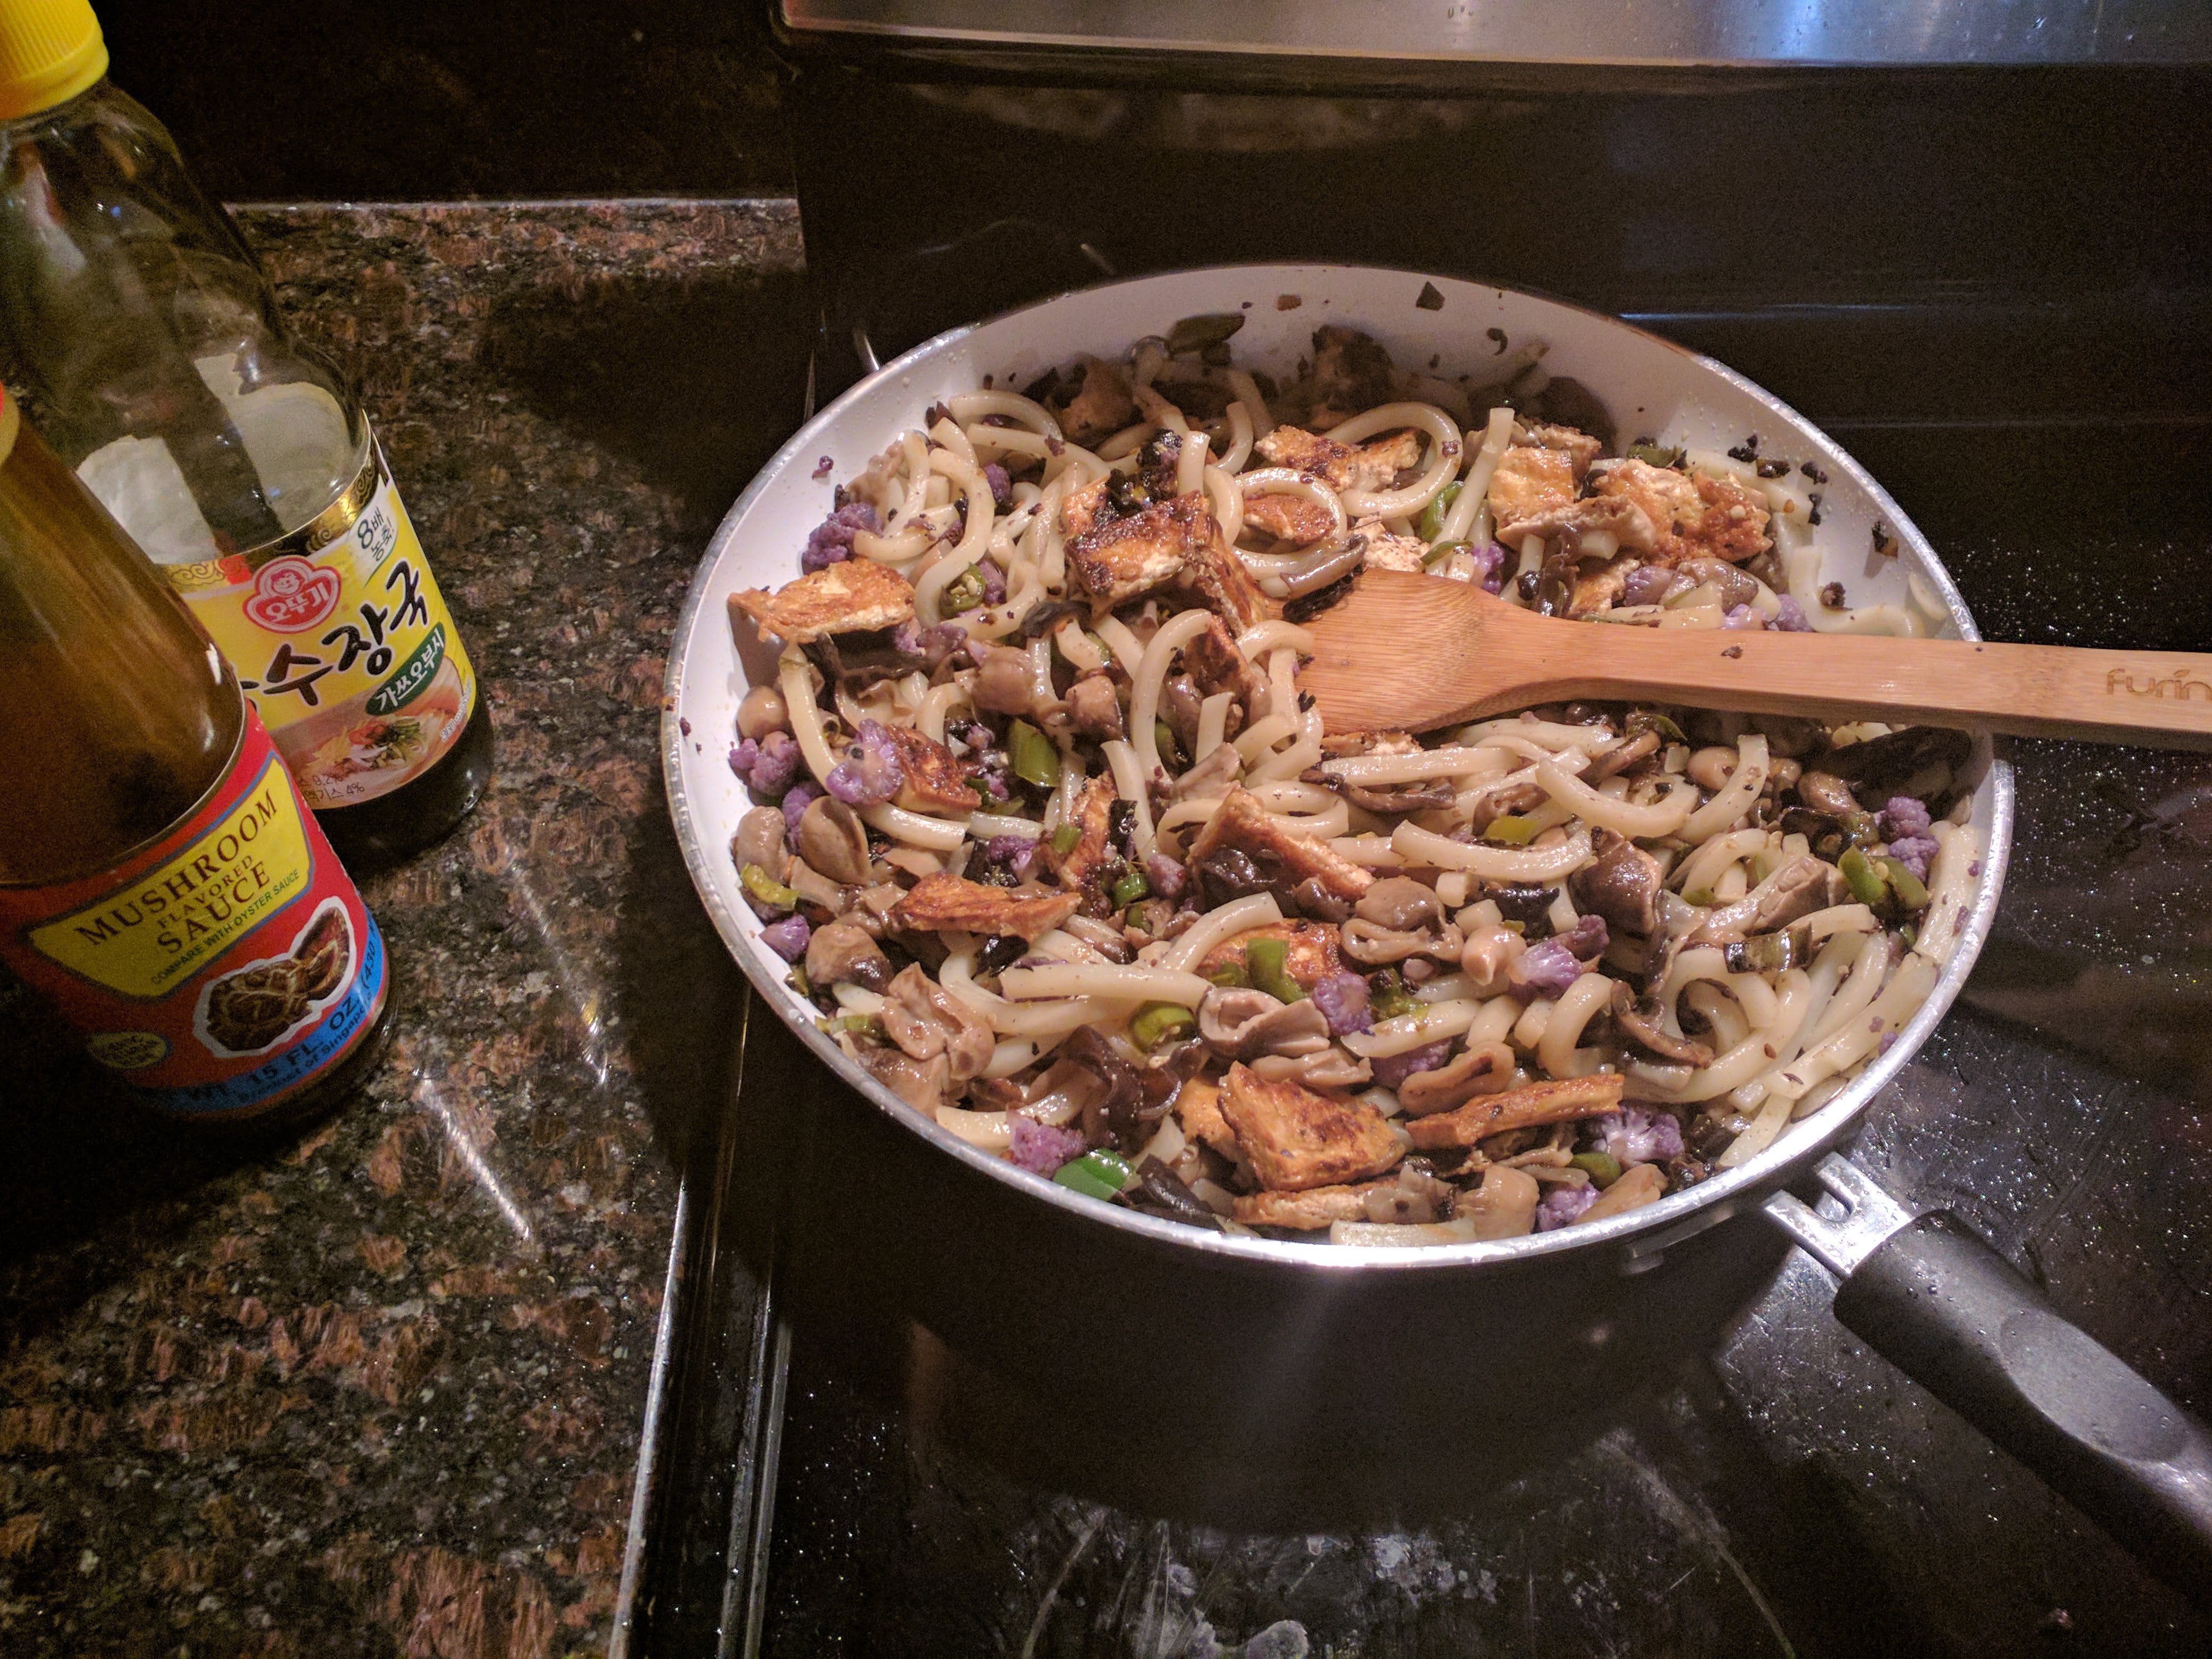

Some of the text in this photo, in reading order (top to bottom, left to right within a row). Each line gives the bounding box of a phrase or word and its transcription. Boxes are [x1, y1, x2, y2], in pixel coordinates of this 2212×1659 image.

[266, 582, 330, 623] 오뚜기
[376, 628, 445, 711] 가쓰오부시
[346, 782, 365, 795] 4%
[73, 789, 278, 945] MUSHROOM
[157, 855, 253, 928] FLAVORED
[151, 868, 300, 985] COMPARE WITH OYSTER SAUCE
[157, 861, 270, 953] SAUCE
[249, 1064, 279, 1085] 15
